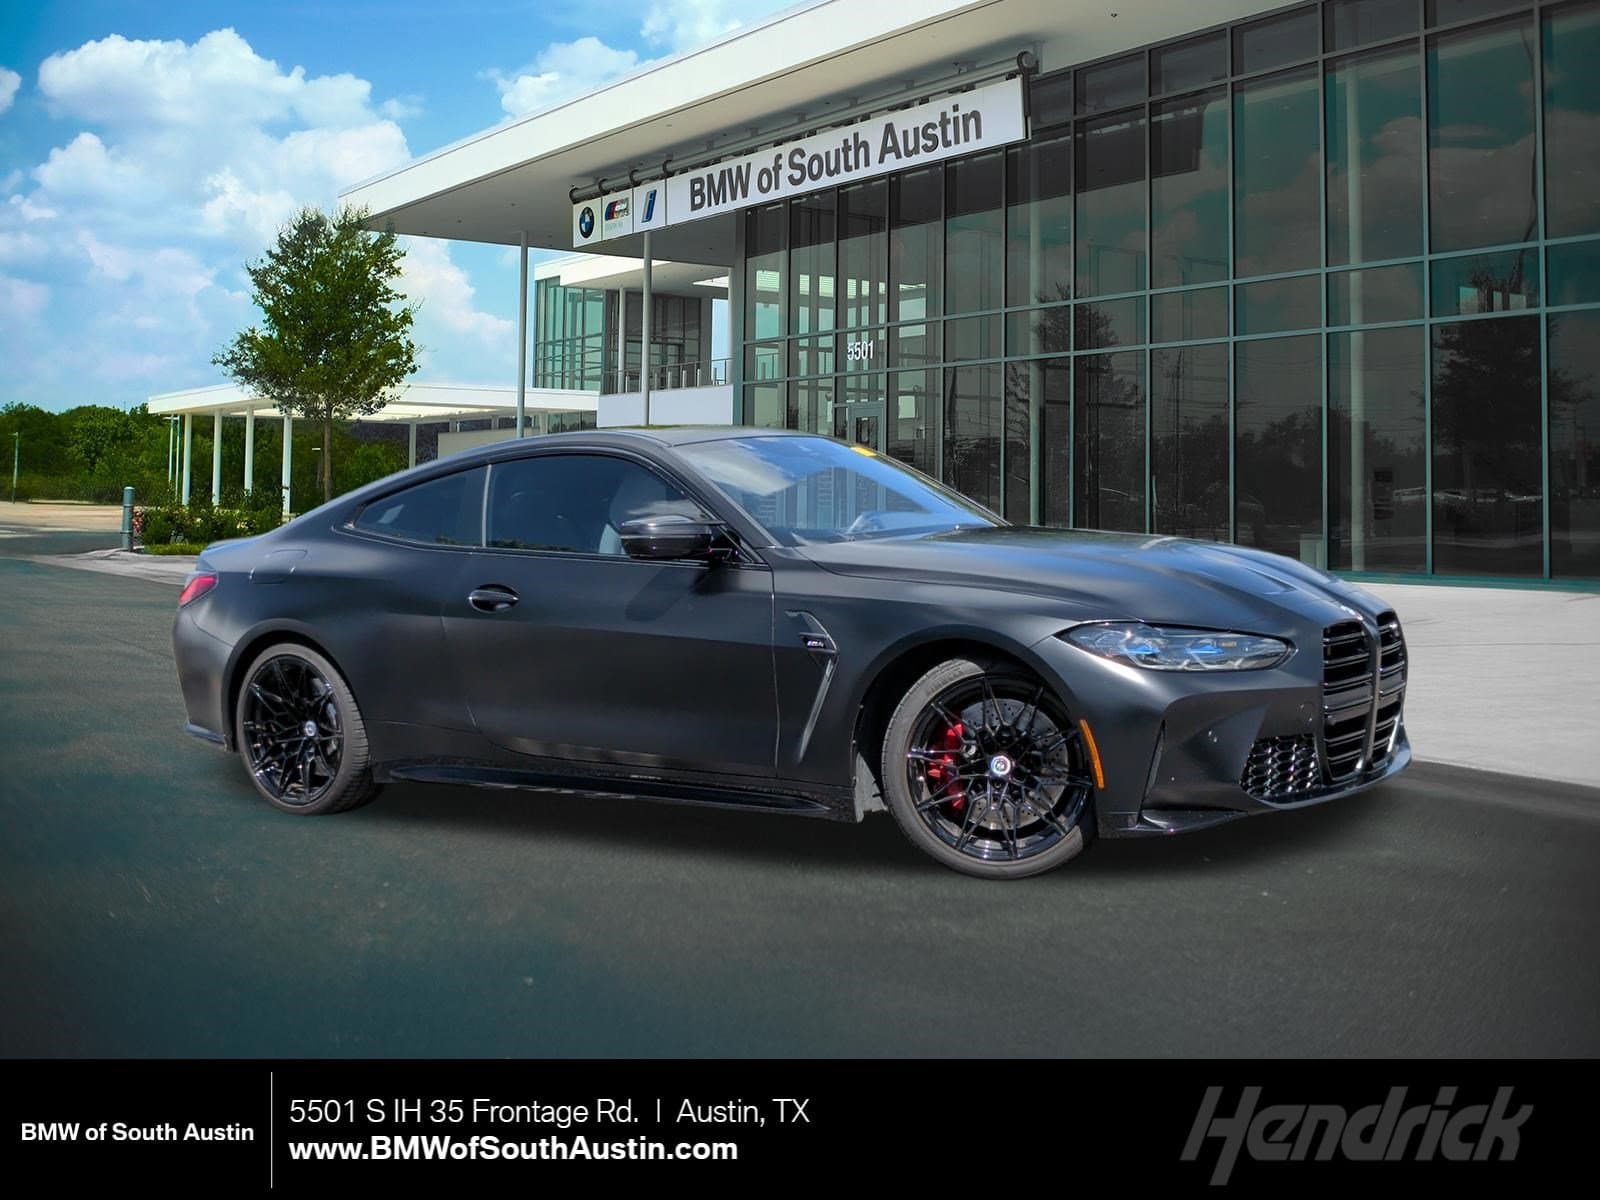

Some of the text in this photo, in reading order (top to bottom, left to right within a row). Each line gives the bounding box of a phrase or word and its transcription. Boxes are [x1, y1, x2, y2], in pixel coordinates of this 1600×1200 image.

[689, 162, 752, 212] BMW
[756, 152, 783, 194] of
[787, 131, 870, 187] South
[877, 103, 983, 165] Austin
[847, 340, 874, 361] 5501
